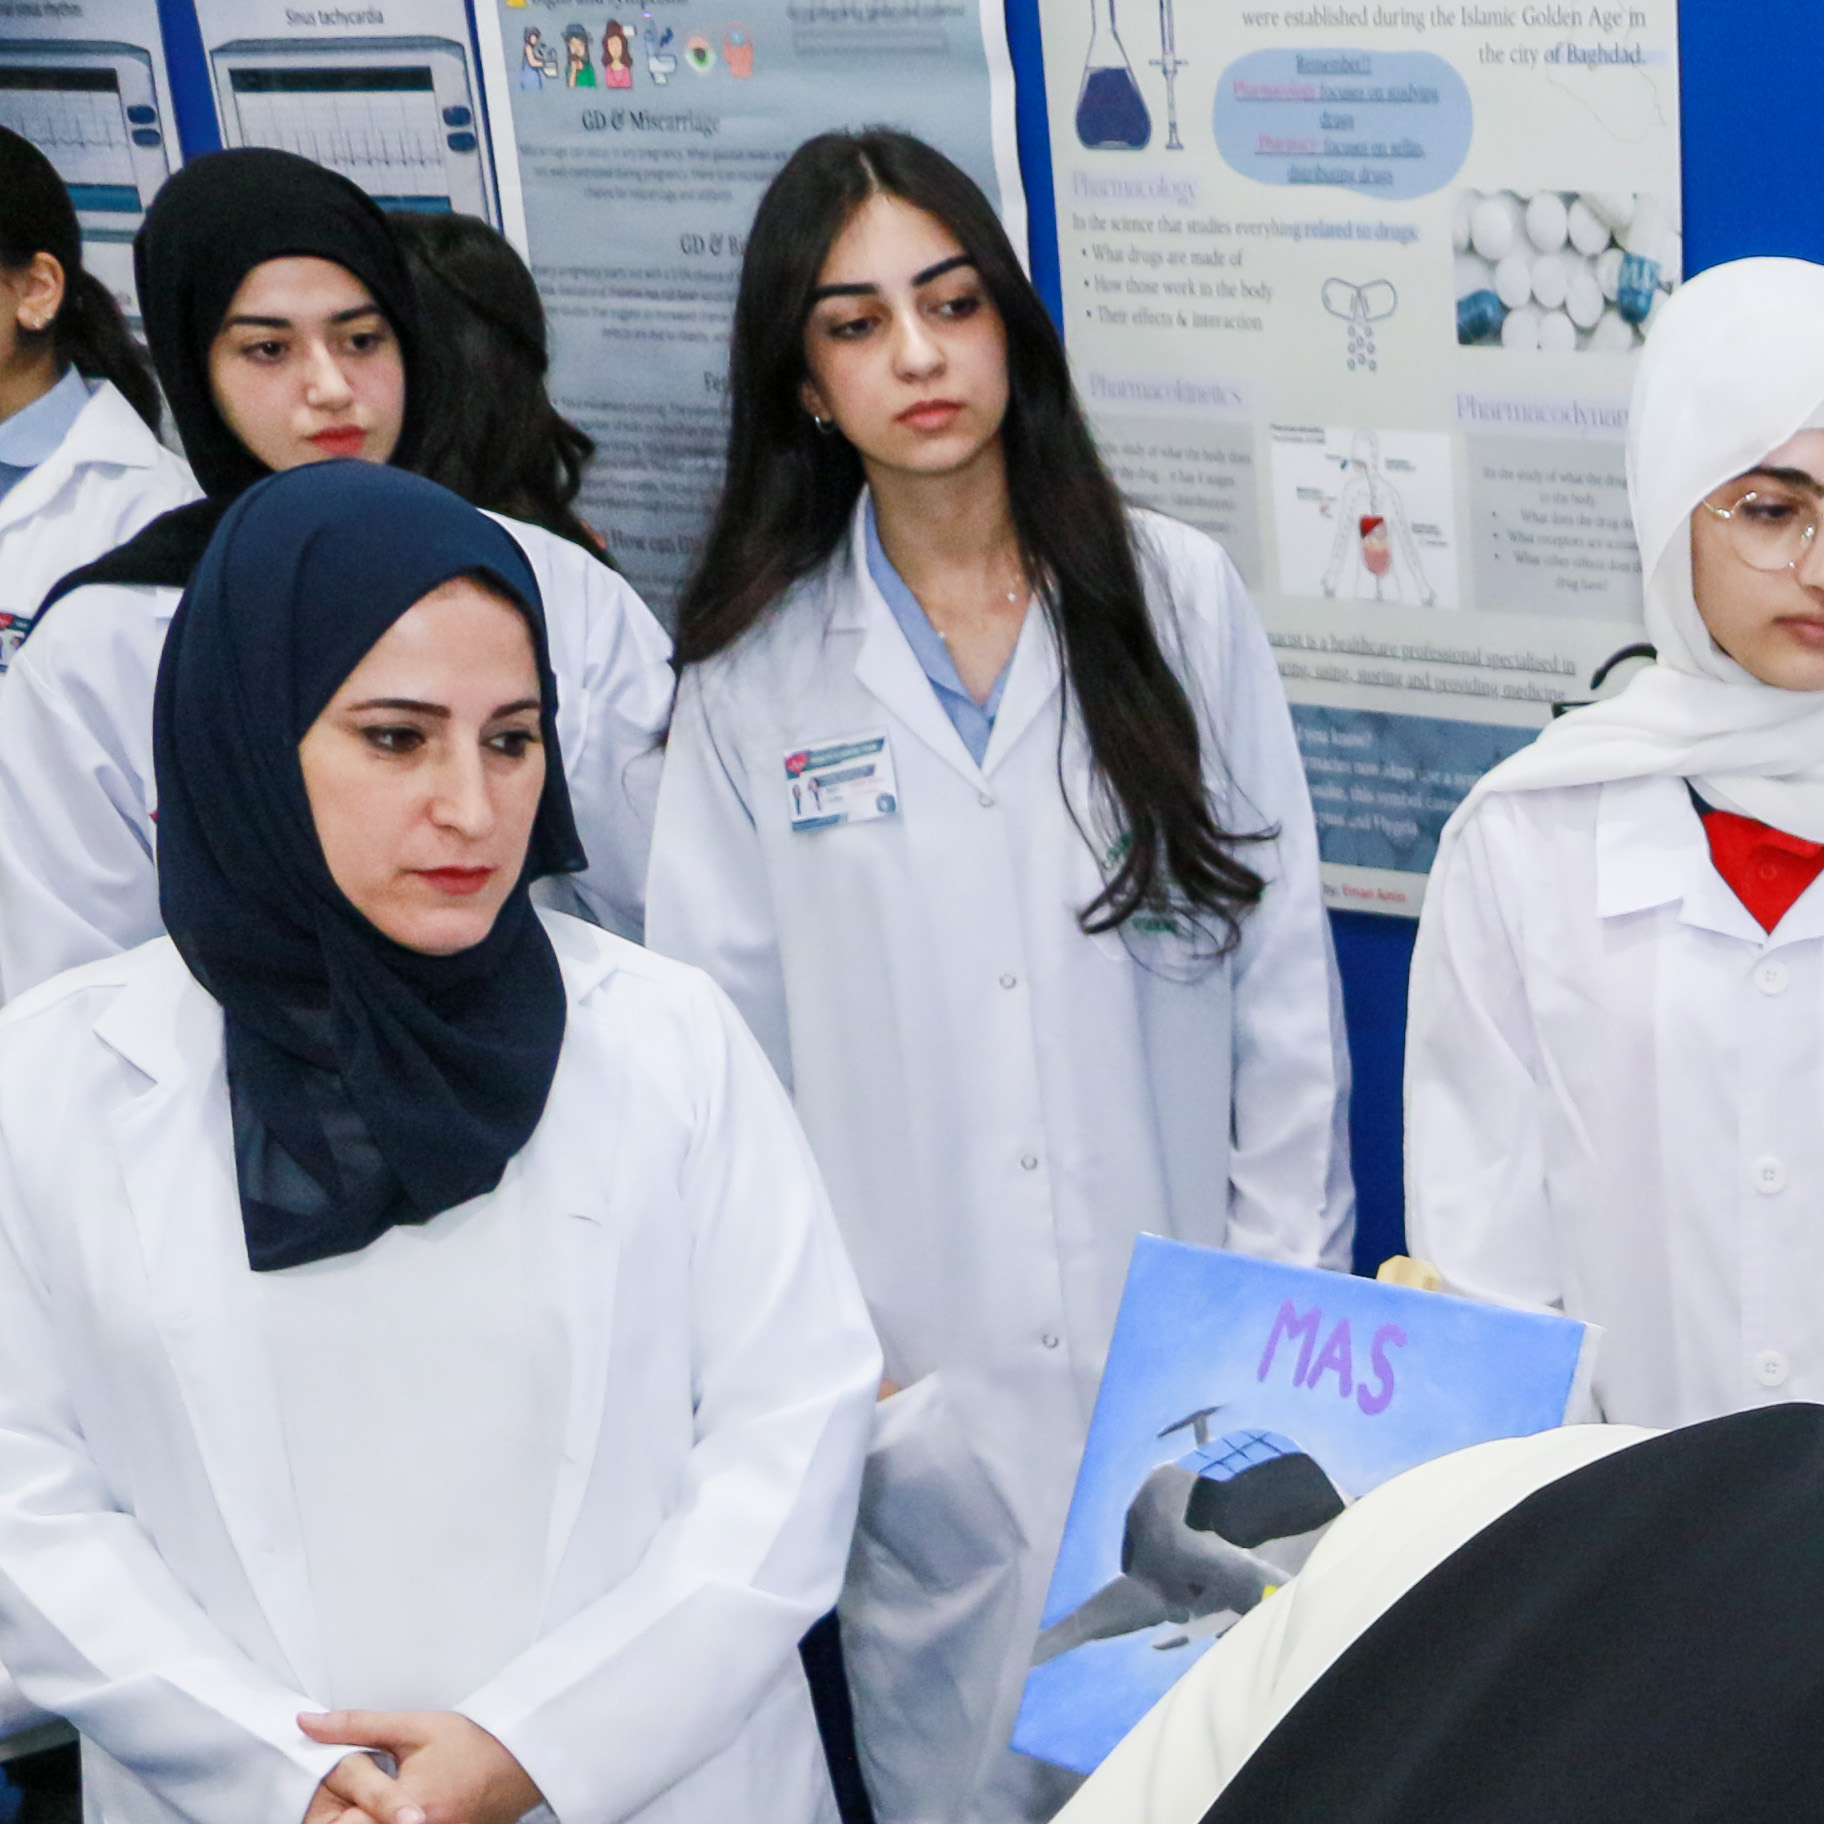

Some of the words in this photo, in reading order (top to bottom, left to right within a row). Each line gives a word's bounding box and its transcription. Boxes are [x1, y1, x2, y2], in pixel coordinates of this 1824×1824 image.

[317, 8, 386, 27] tachycardia
[1242, 10, 1280, 28] were
[1284, 5, 1368, 28] established
[1373, 5, 1425, 31] during
[1430, 6, 1456, 28] the
[1461, 6, 1517, 28] Islamic
[1522, 5, 1584, 28] Golden
[1588, 7, 1622, 32] Age
[1629, 8, 1647, 28] in
[1478, 44, 1504, 64] the
[1510, 44, 1539, 68] city
[1545, 42, 1563, 64] of
[1566, 42, 1647, 70] Baghdad.
[582, 109, 606, 132] GD
[630, 109, 720, 137] Miscarriage
[1072, 171, 1197, 207] Pharmacology
[1256, 1298, 1408, 1416] MAS
